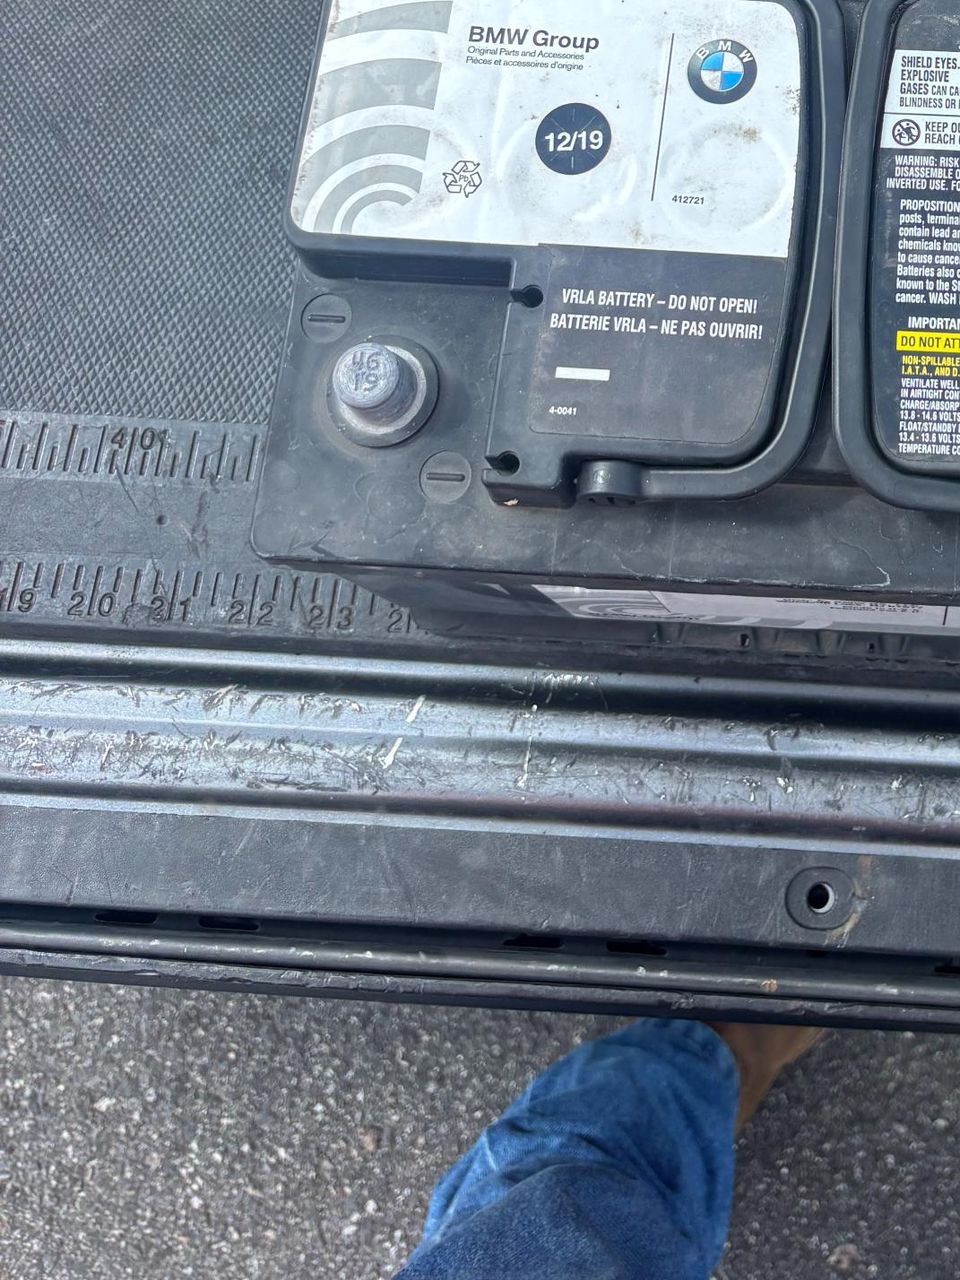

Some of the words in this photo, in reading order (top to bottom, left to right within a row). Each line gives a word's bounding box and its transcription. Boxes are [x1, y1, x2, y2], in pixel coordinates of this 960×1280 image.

[469, 26, 528, 45] BMW
[533, 30, 599, 52] Group
[467, 46, 498, 56] Original
[500, 48, 519, 56] Parts
[538, 50, 584, 60] Accessories
[466, 56, 492, 65] Pièces
[503, 60, 549, 68] accessoires
[551, 62, 583, 71] d'origine
[901, 56, 932, 68] SHIELD
[935, 57, 960, 70] EYES.
[901, 70, 949, 82] EXPLOSIVE
[900, 83, 928, 95] GASES
[932, 85, 947, 95] CAN
[900, 97, 942, 108] BLINDNESS
[945, 98, 956, 109] OR
[925, 121, 948, 133] KEEP
[544, 130, 604, 152] 12/19
[925, 133, 955, 145] REACH
[458, 174, 469, 183] Pb
[672, 194, 705, 206] 412721
[563, 289, 594, 304] VRLA
[599, 291, 654, 308] BATTERY
[669, 295, 687, 310] DO
[690, 296, 716, 311] NOT
[719, 298, 757, 314] OPEN!
[551, 313, 610, 331] BATTERIE
[614, 317, 646, 333] VRLA
[661, 320, 678, 335] NE
[681, 321, 705, 336] PAS
[710, 323, 762, 339] OUVRIR!
[901, 336, 915, 346] DO
[919, 337, 940, 348] NOT
[549, 406, 577, 415] 4-0041
